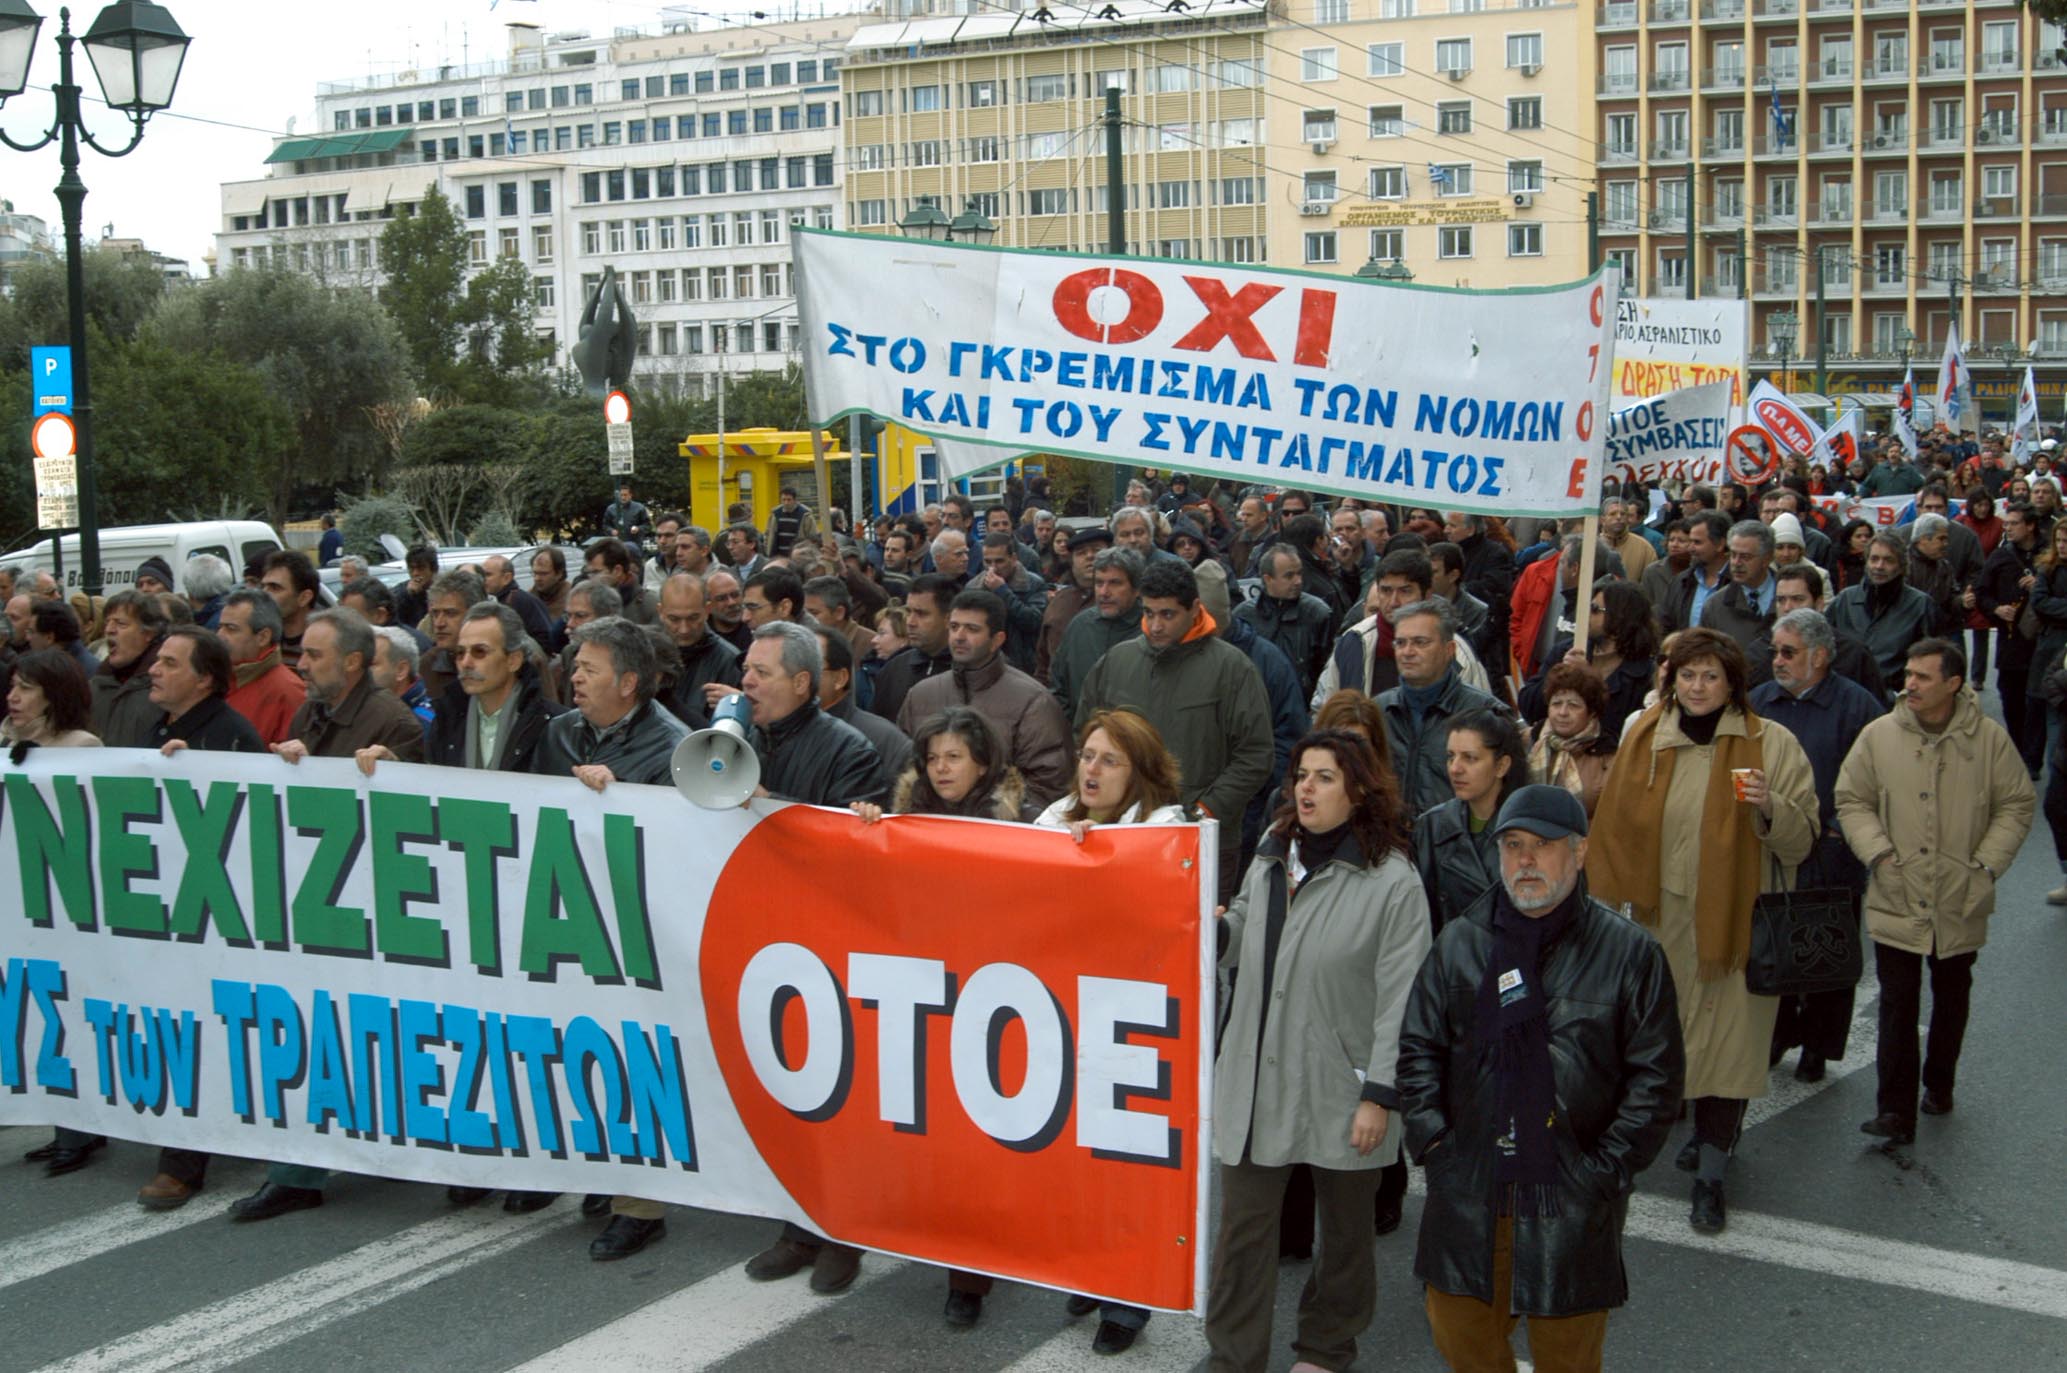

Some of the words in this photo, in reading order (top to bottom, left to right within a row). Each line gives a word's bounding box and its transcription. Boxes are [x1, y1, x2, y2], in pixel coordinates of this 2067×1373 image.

[1347, 210, 1416, 220] ΟΡΓΑΝΙΣΜΟΣ
[1418, 217, 1437, 225] ΚΑΙ
[46, 358, 58, 376] P
[1052, 267, 1336, 369] ΟΧΙ
[827, 322, 926, 374] ΣΤΟ
[949, 341, 1272, 412] ΓΚΡΕΜΙΣΜΑ
[1294, 378, 1398, 428] ΤΩΝ
[1414, 393, 1565, 442] ΝΟΜΩΝ
[902, 387, 990, 430] ΚΑΙ
[1012, 398, 1121, 442] ΤΟΥ
[1139, 411, 1505, 497] ΣΥΝΤΑΓΜΑΤΟΣ
[0, 774, 663, 991] ΝΕΧΙΖΕΤΑΙ
[211, 978, 700, 1173] ΤΡΑΠΕΖΙΤΩΝ
[738, 942, 1182, 1170] ΟΤΟΕ
